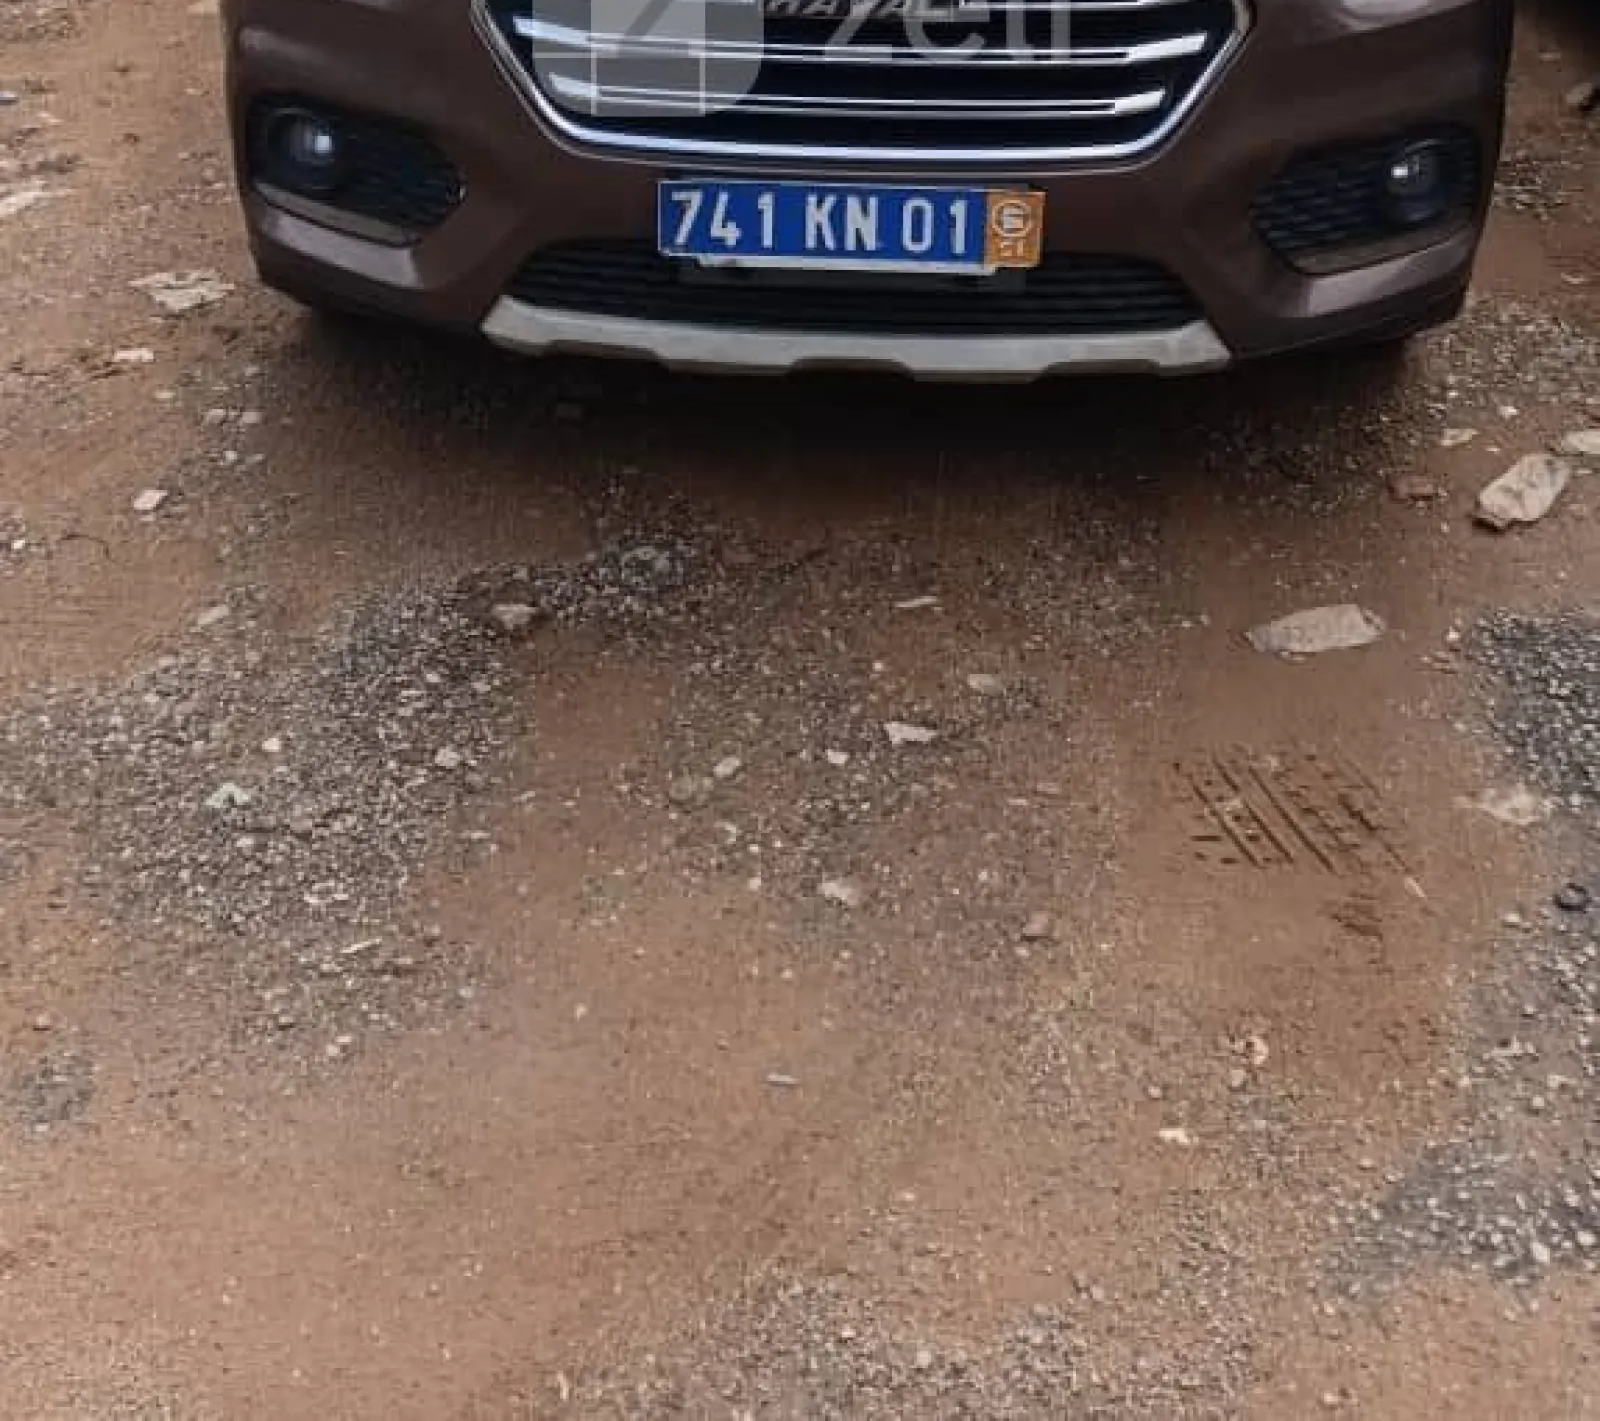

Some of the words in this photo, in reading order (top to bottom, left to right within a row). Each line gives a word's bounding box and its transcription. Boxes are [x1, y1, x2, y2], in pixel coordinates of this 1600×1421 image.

[671, 188, 777, 248] 741
[804, 192, 878, 251] KN
[902, 197, 969, 254] 01
